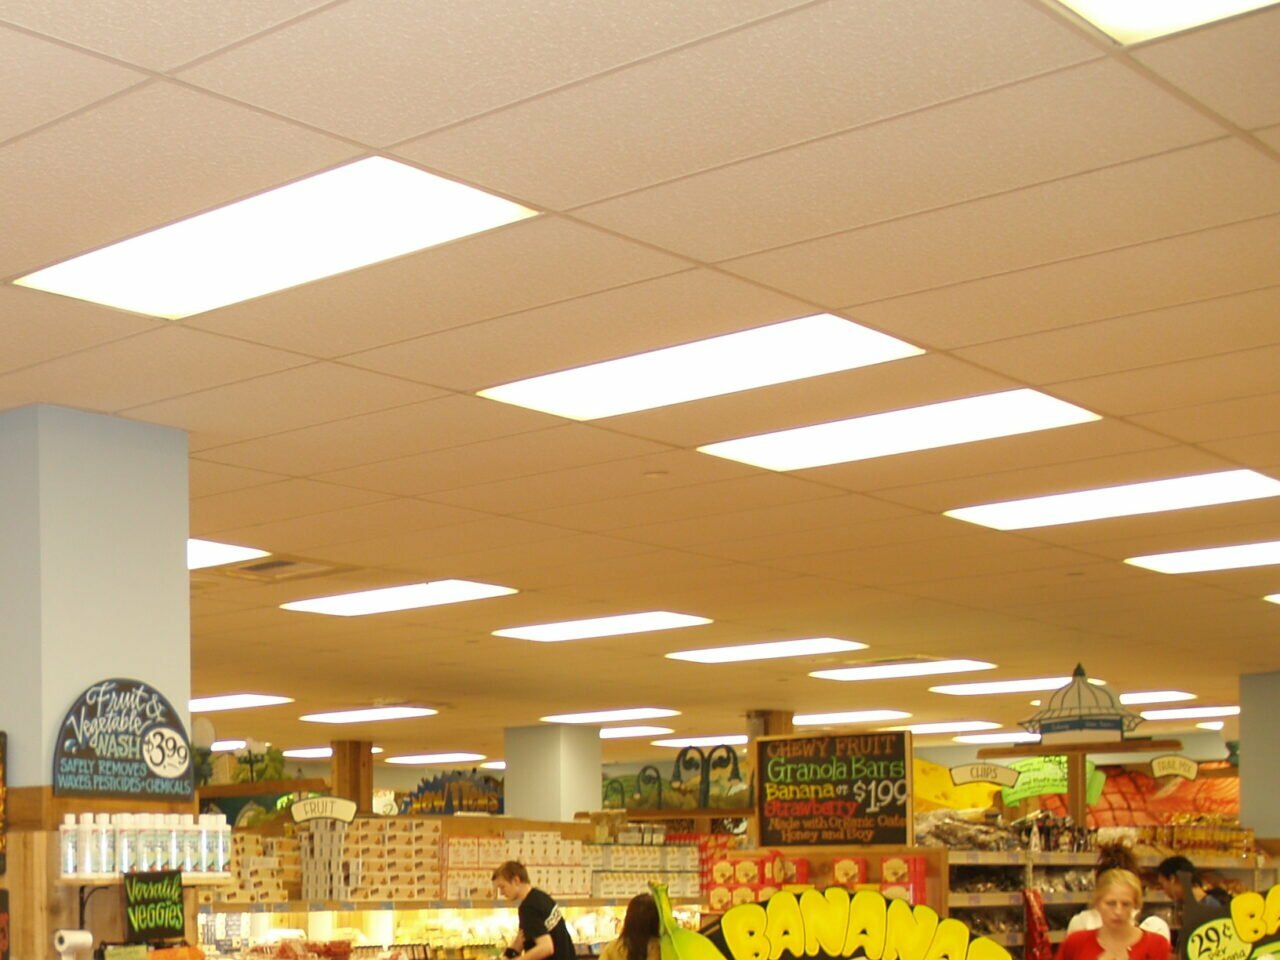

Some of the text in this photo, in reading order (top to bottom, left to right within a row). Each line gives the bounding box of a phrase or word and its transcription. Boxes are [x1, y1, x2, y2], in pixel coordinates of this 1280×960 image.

[86, 682, 166, 722] Fruit &
[66, 705, 153, 748] Vegetable
[96, 734, 141, 759] WASH
[767, 734, 896, 757] CHEWY FRUIT
[60, 758, 147, 776] SAFELY REMOVES
[767, 755, 905, 783] Granola Bars
[970, 766, 998, 779] CHIPS
[765, 782, 835, 801] Banana
[303, 800, 335, 816] FRUIT
